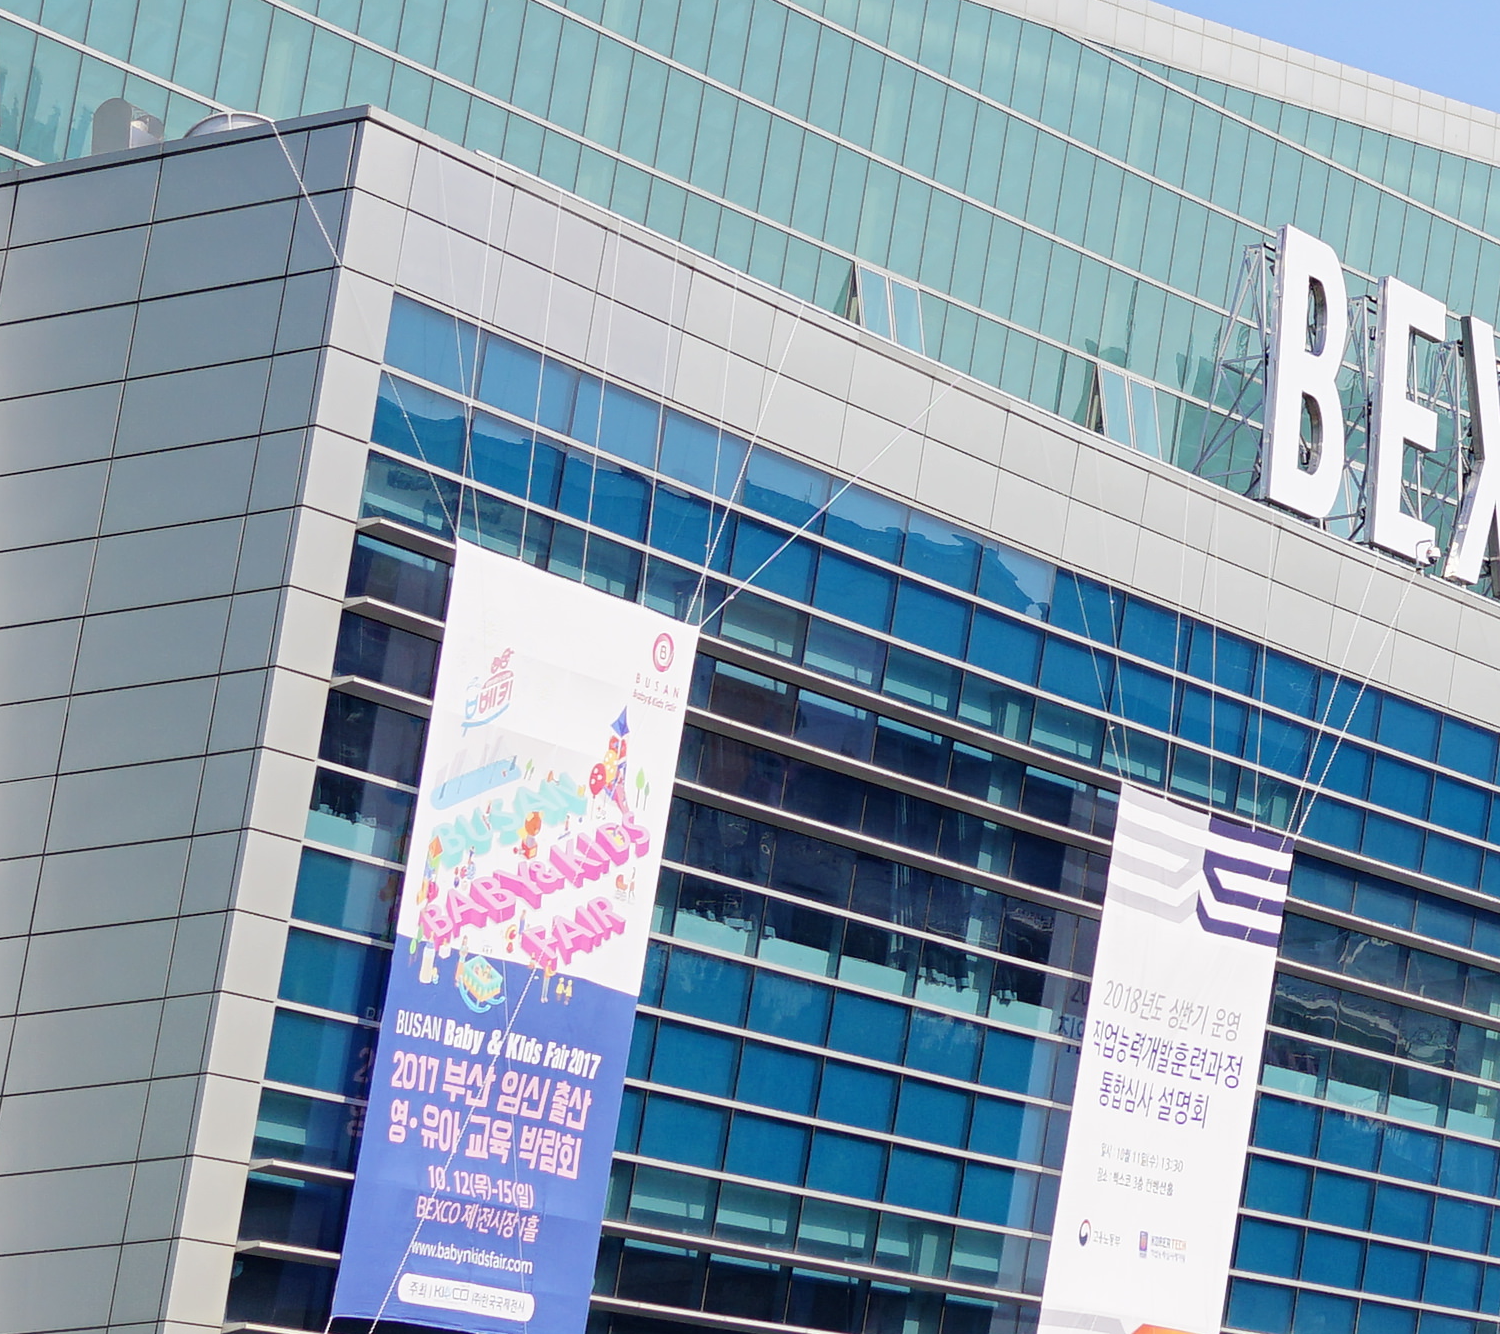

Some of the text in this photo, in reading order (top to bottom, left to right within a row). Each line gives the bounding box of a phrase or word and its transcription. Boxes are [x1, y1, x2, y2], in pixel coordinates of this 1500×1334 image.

[635, 672, 680, 699] BUSAN
[431, 771, 588, 869] BUSAN
[419, 810, 651, 952] BABY&KIDS
[520, 895, 626, 973] FAIR
[395, 1010, 443, 1042] BUSAN
[443, 1019, 486, 1055] Baby
[486, 1029, 505, 1056] &
[1102, 979, 1242, 1042] 2018년도 상반기 운영
[1092, 1019, 1244, 1089] 직업능력개발훈련과정
[390, 1050, 593, 1131] 2017 부산 임신 출산
[1098, 1070, 1210, 1130] 통합심사 설명회
[464, 1114, 513, 1165] 교육
[518, 1124, 582, 1181] 박람회
[416, 1195, 462, 1225] BEXCO
